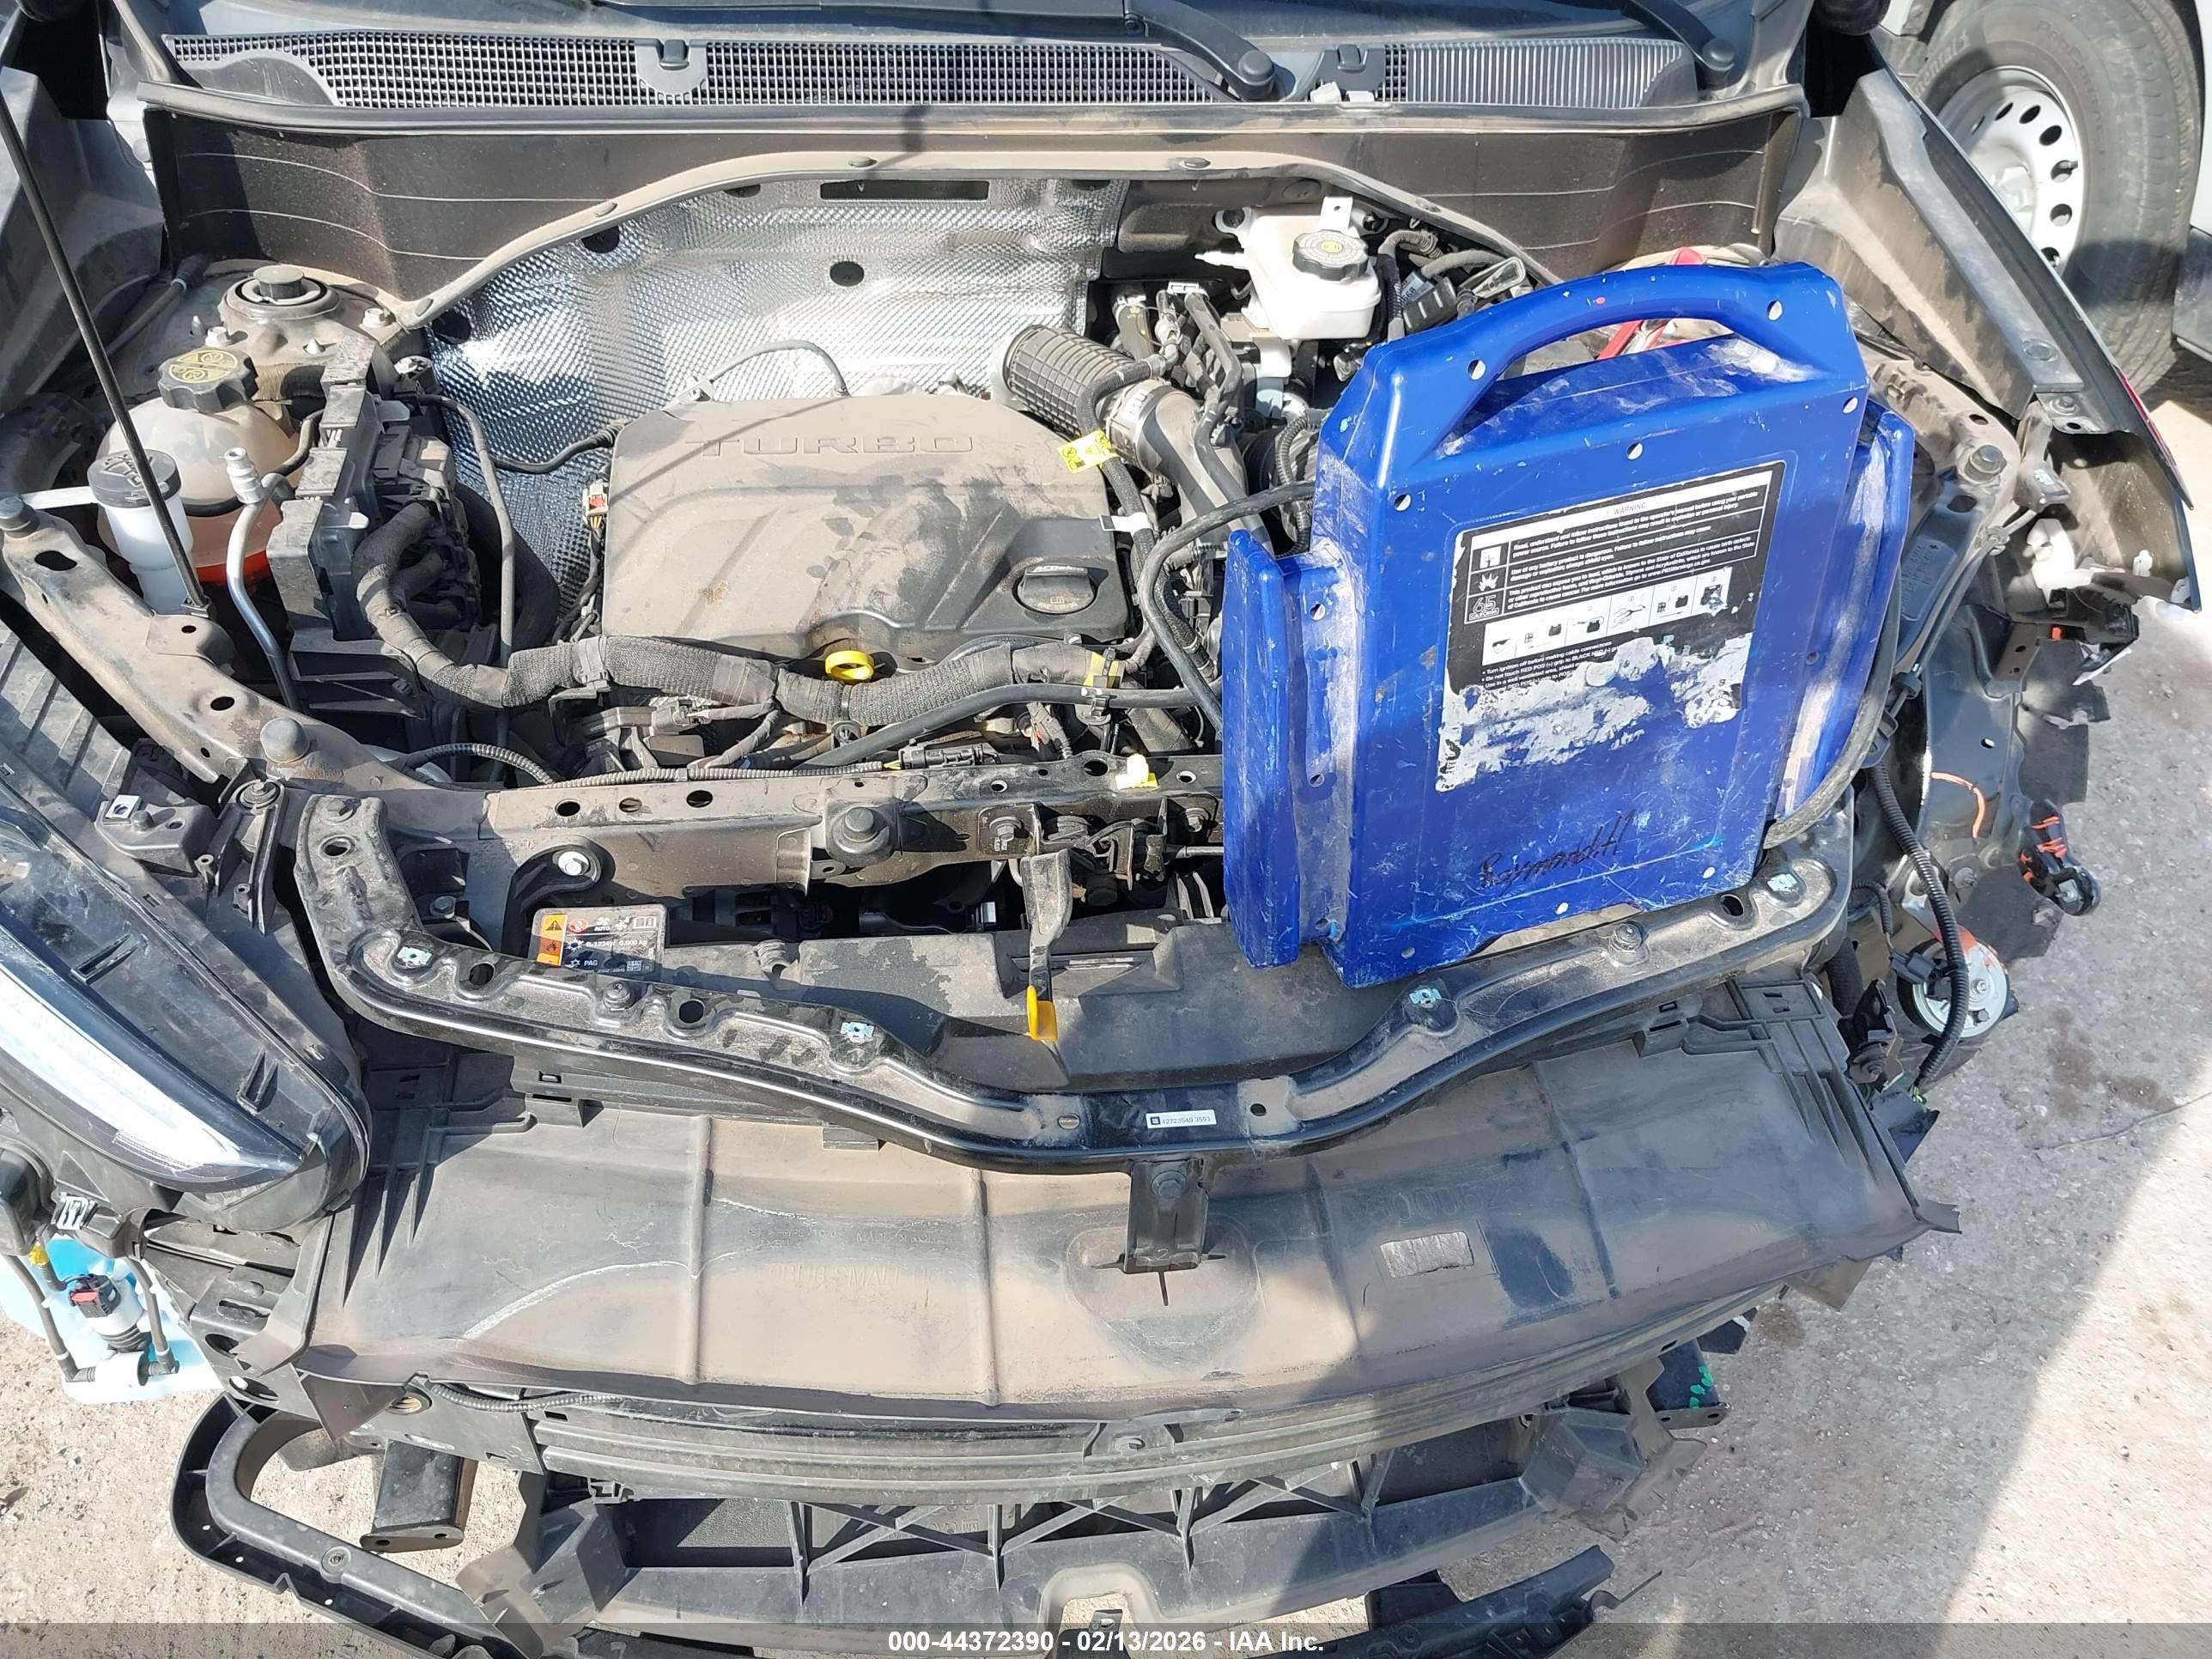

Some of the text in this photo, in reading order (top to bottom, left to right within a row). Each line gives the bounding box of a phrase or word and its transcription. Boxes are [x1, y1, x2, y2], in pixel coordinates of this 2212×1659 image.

[685, 435, 974, 457] TURBO
[1613, 503, 1647, 514] WARNING
[1473, 595, 1496, 612] 65
